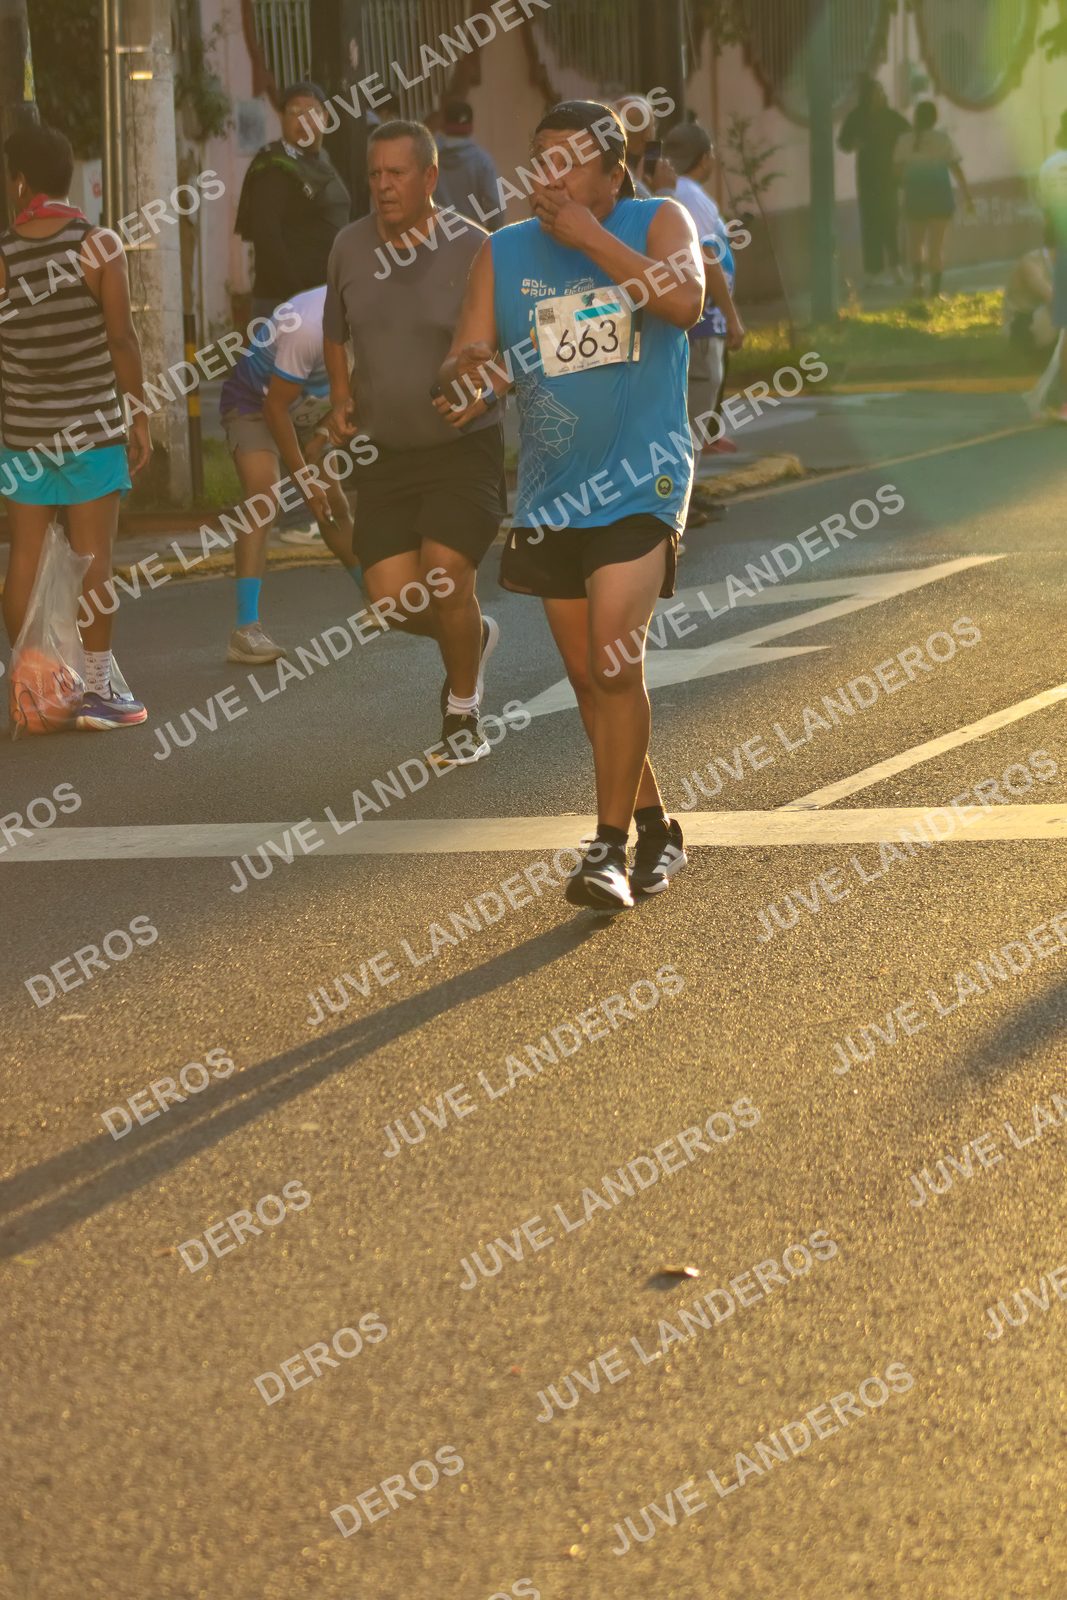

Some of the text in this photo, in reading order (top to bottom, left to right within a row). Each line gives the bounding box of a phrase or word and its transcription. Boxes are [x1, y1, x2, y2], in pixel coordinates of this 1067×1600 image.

[522, 279, 547, 289] GDL
[530, 287, 557, 297] RUN
[556, 319, 619, 363] 663
